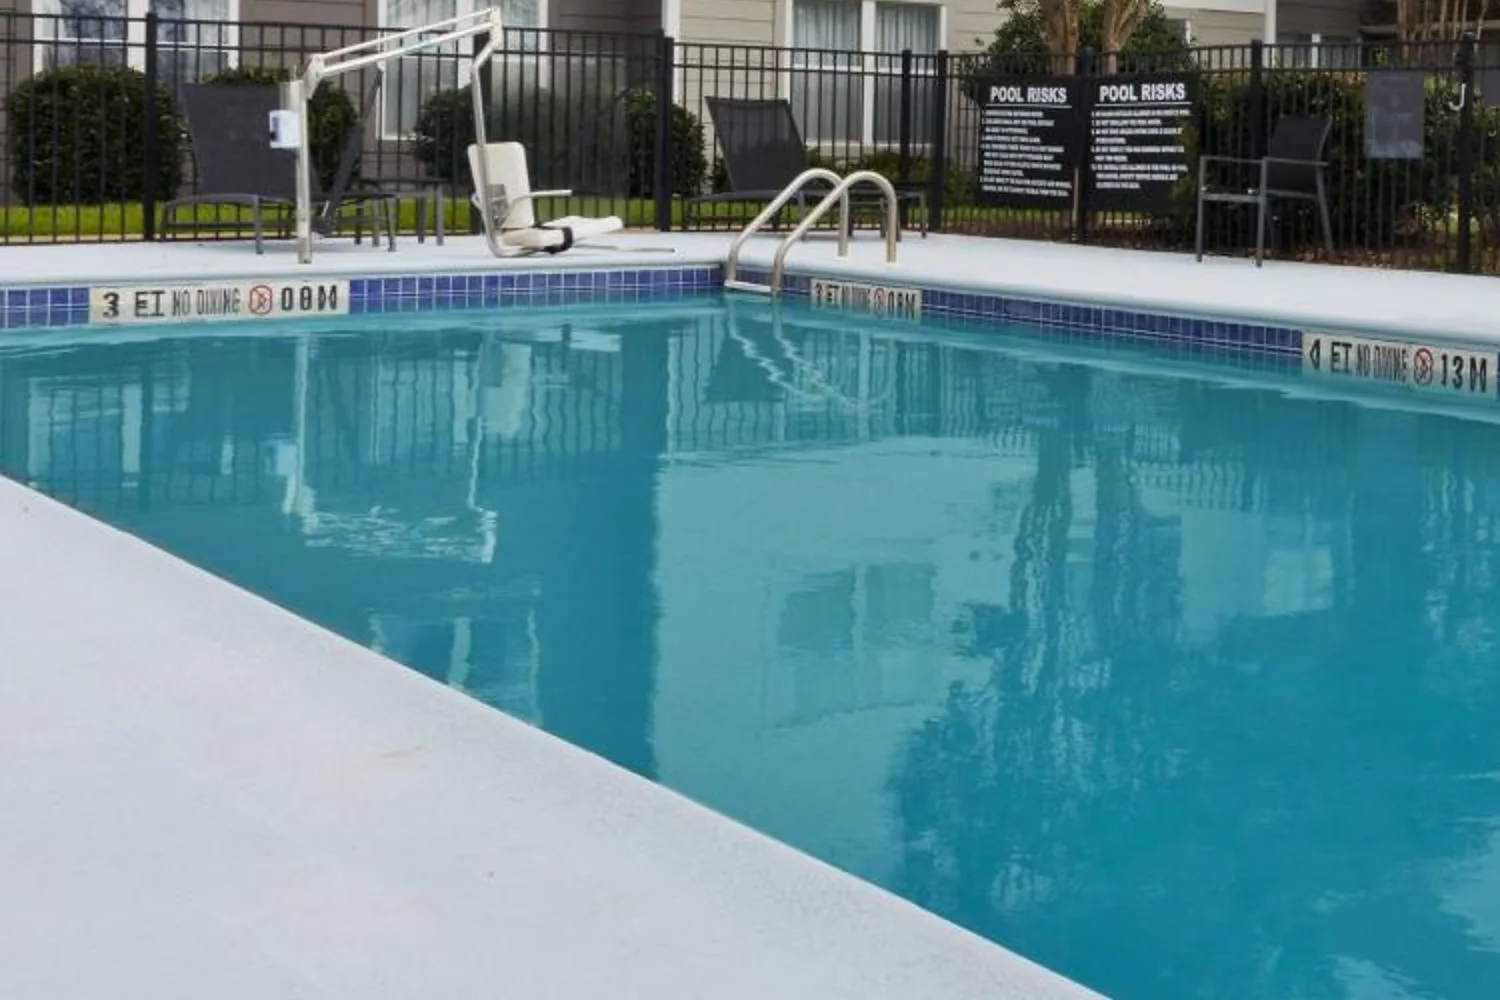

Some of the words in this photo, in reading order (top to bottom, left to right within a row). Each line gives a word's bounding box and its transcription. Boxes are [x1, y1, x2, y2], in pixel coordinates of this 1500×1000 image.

[990, 86, 1024, 102] POOL
[1027, 87, 1067, 103] RISKS
[1100, 85, 1137, 101] POOL
[1141, 83, 1185, 100] RISKS
[103, 291, 119, 318] 3
